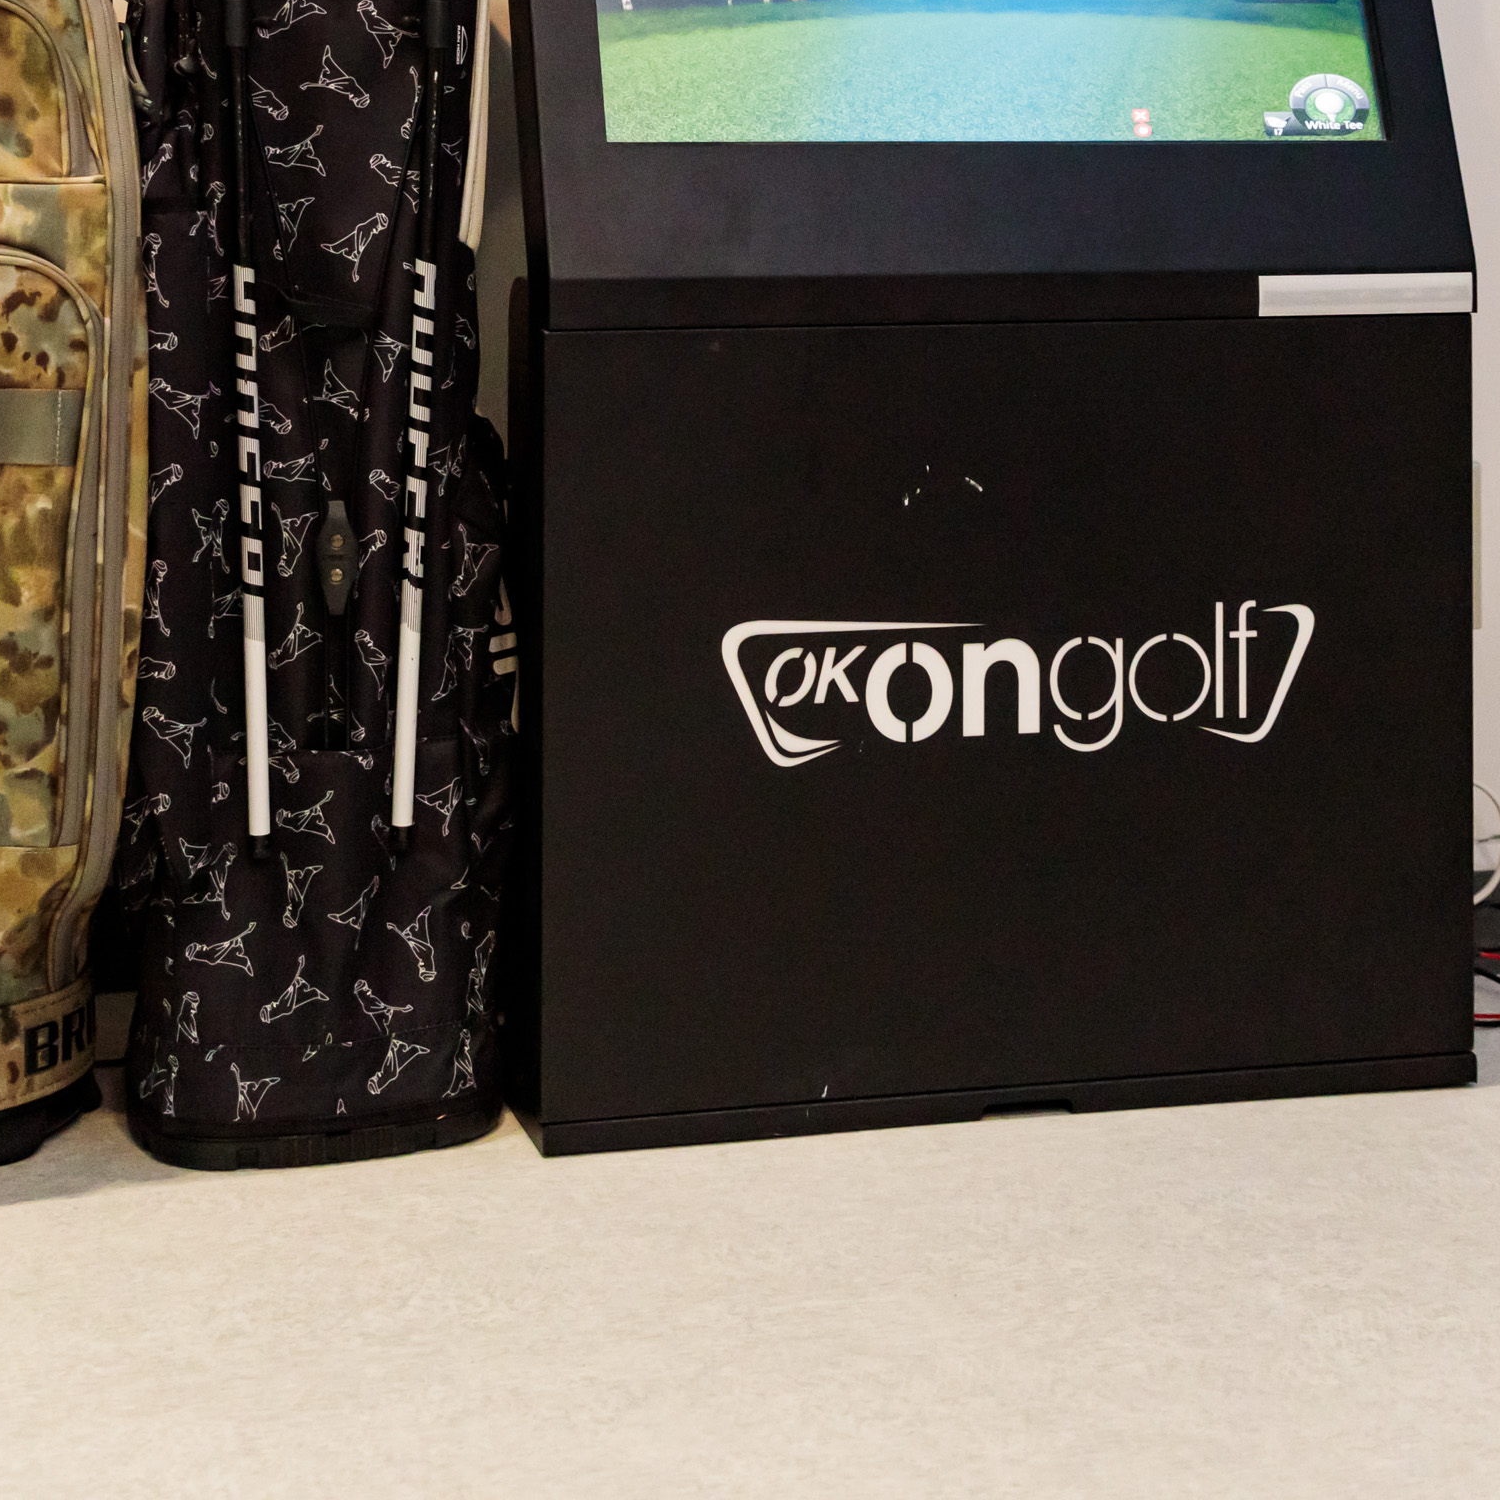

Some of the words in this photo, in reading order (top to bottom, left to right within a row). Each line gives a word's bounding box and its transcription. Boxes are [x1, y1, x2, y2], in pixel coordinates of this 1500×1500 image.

[1337, 78, 1364, 100] Menu
[1305, 120, 1341, 130] White
[1343, 120, 1364, 130] Tee
